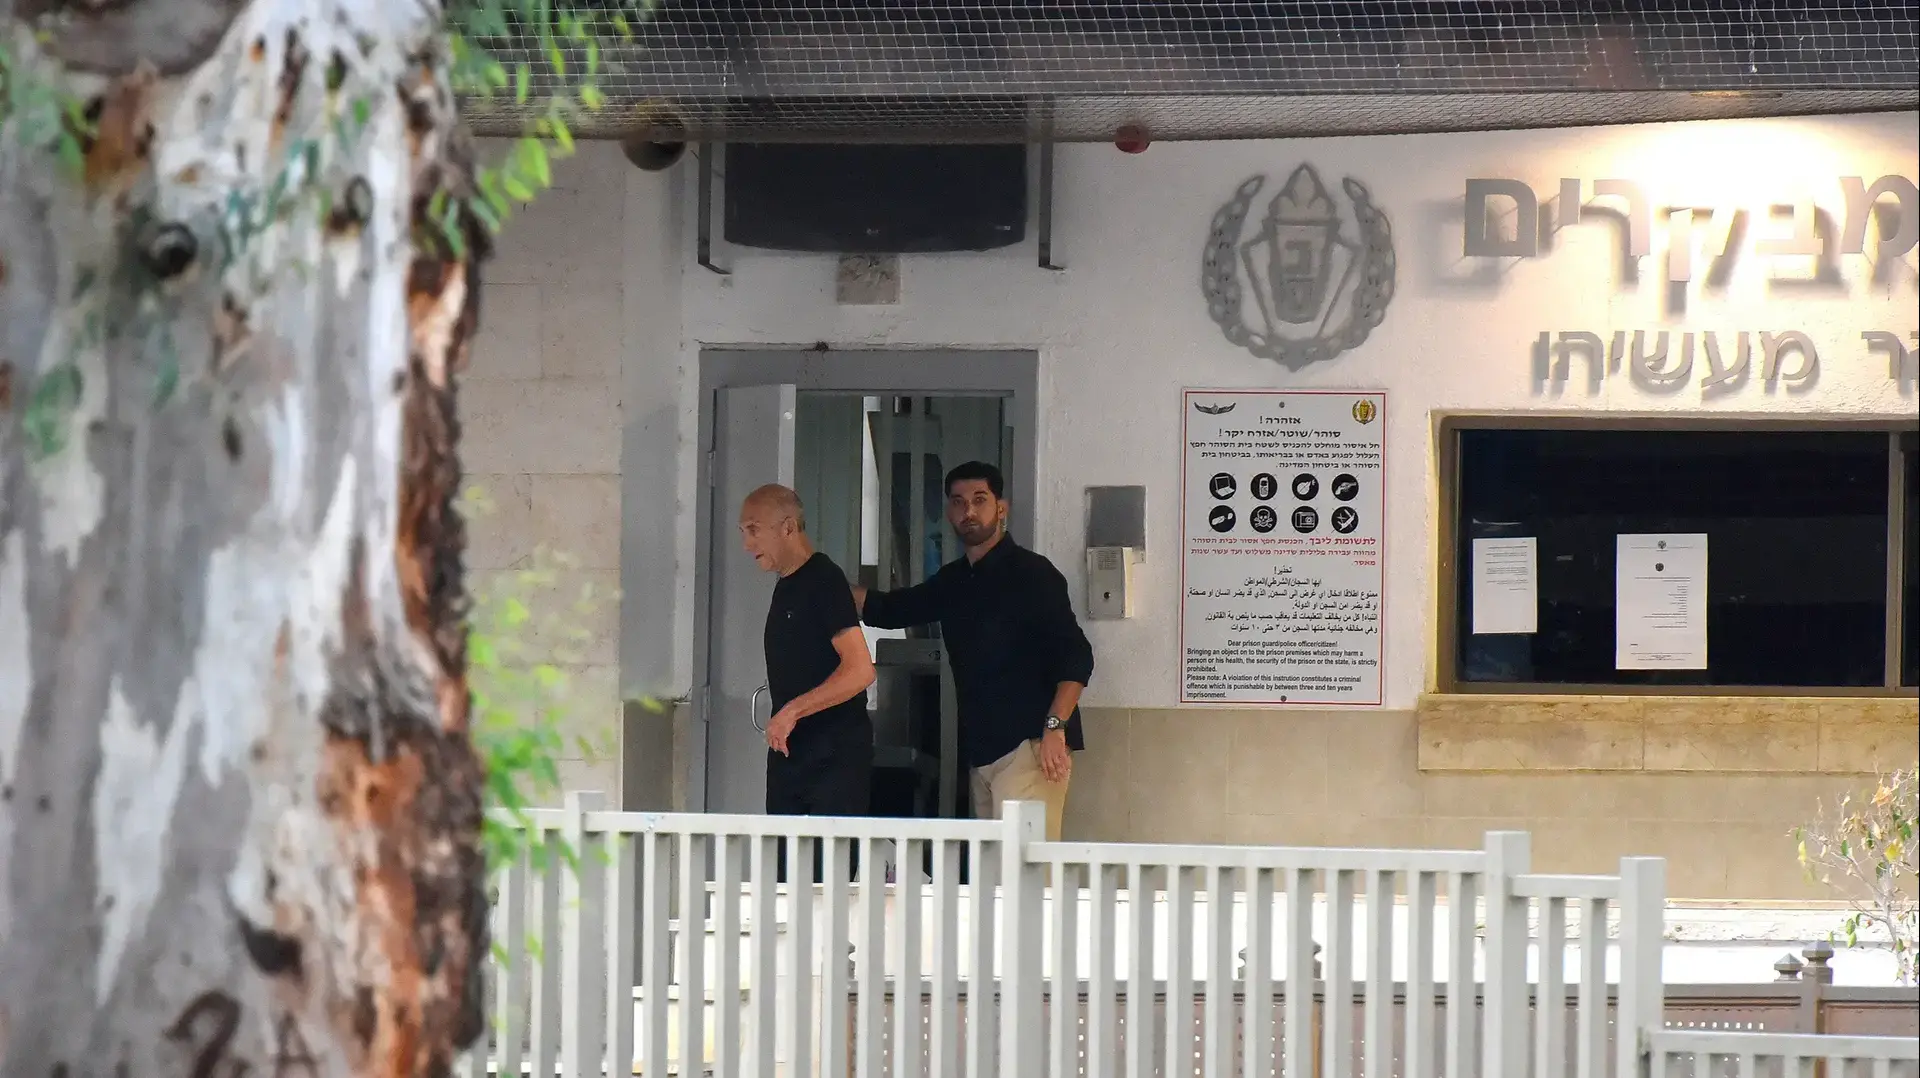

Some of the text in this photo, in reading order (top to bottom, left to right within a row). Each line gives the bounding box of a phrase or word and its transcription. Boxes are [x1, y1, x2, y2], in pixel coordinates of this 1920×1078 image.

[1538, 330, 1918, 390] ר מעשיהו
[1186, 647, 1211, 656] Bringing
[1221, 648, 1239, 657] object
[1265, 648, 1284, 656] prison
[1186, 658, 1206, 666] person
[1297, 657, 1315, 665] prison
[1186, 673, 1205, 681] Please
[1265, 683, 1273, 691] by
